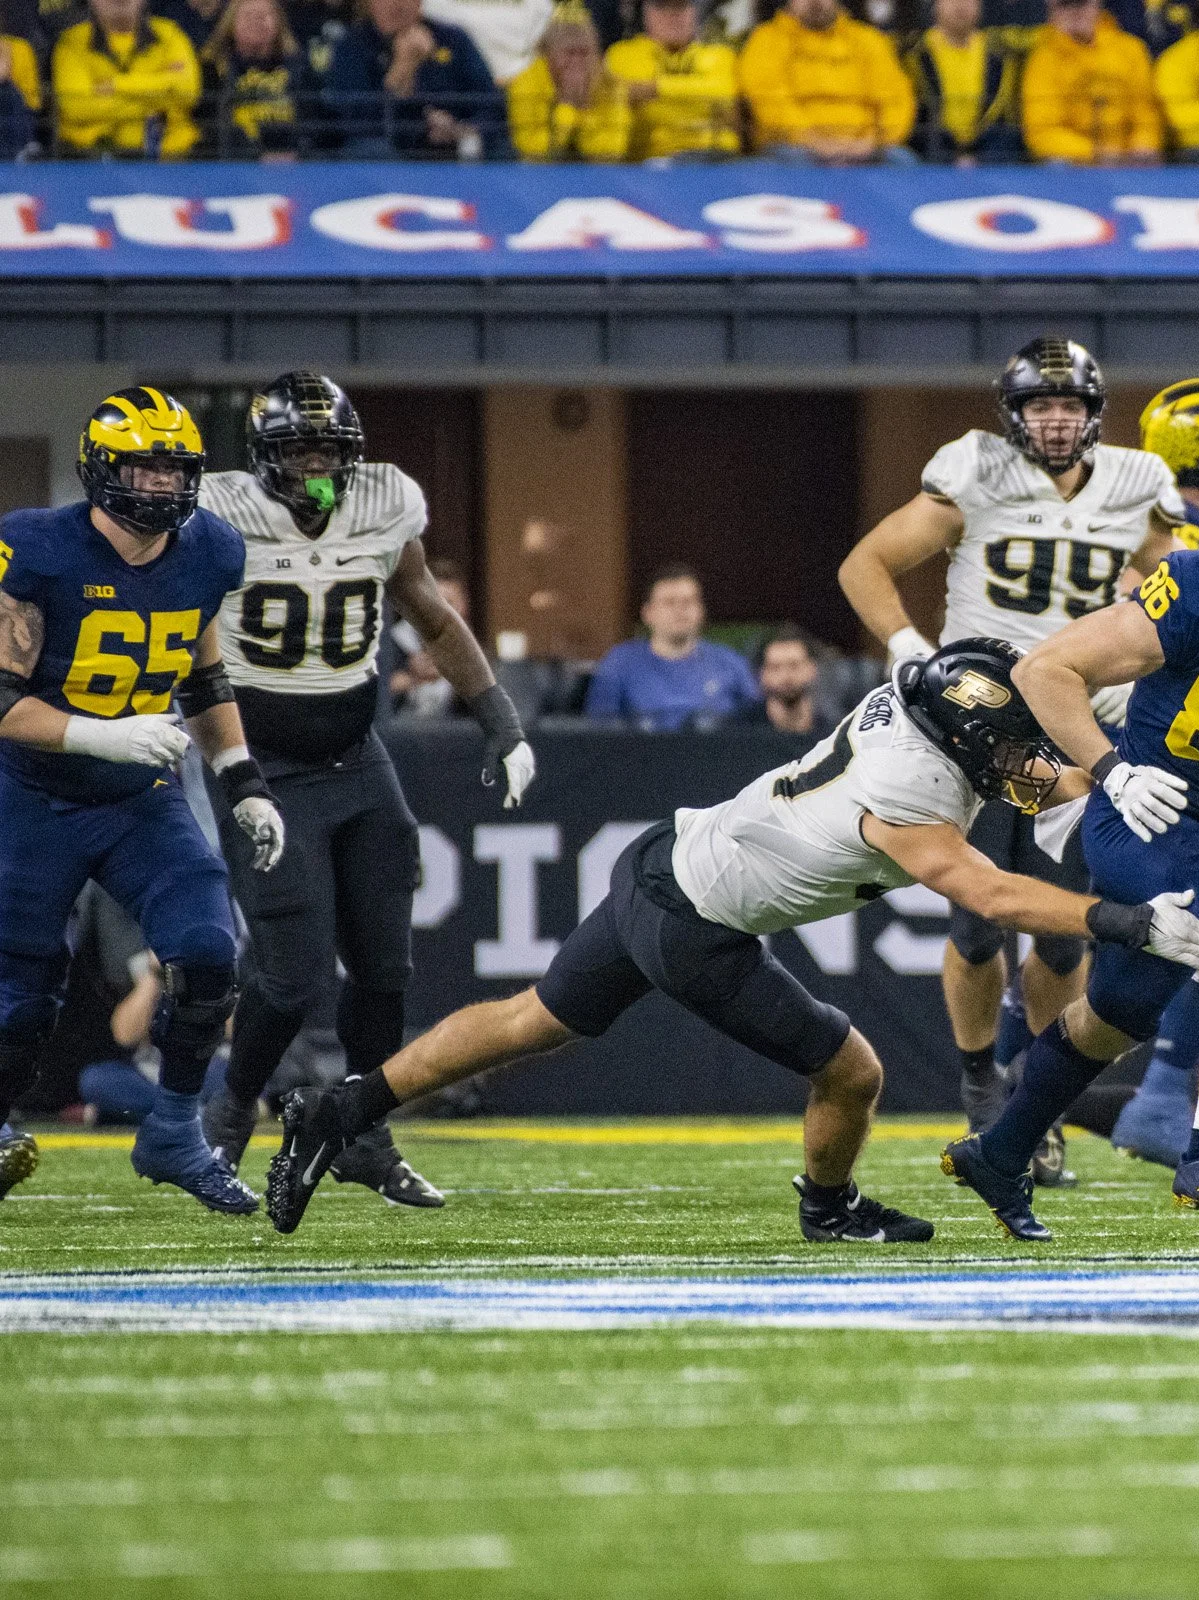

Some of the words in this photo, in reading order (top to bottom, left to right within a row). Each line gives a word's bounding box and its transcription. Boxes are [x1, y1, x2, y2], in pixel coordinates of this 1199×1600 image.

[0, 193, 867, 251] LUCAS
[984, 537, 1125, 620] 99
[1139, 561, 1180, 620] 86
[240, 580, 379, 673] 90
[61, 607, 201, 718] 65
[941, 670, 1012, 710] P
